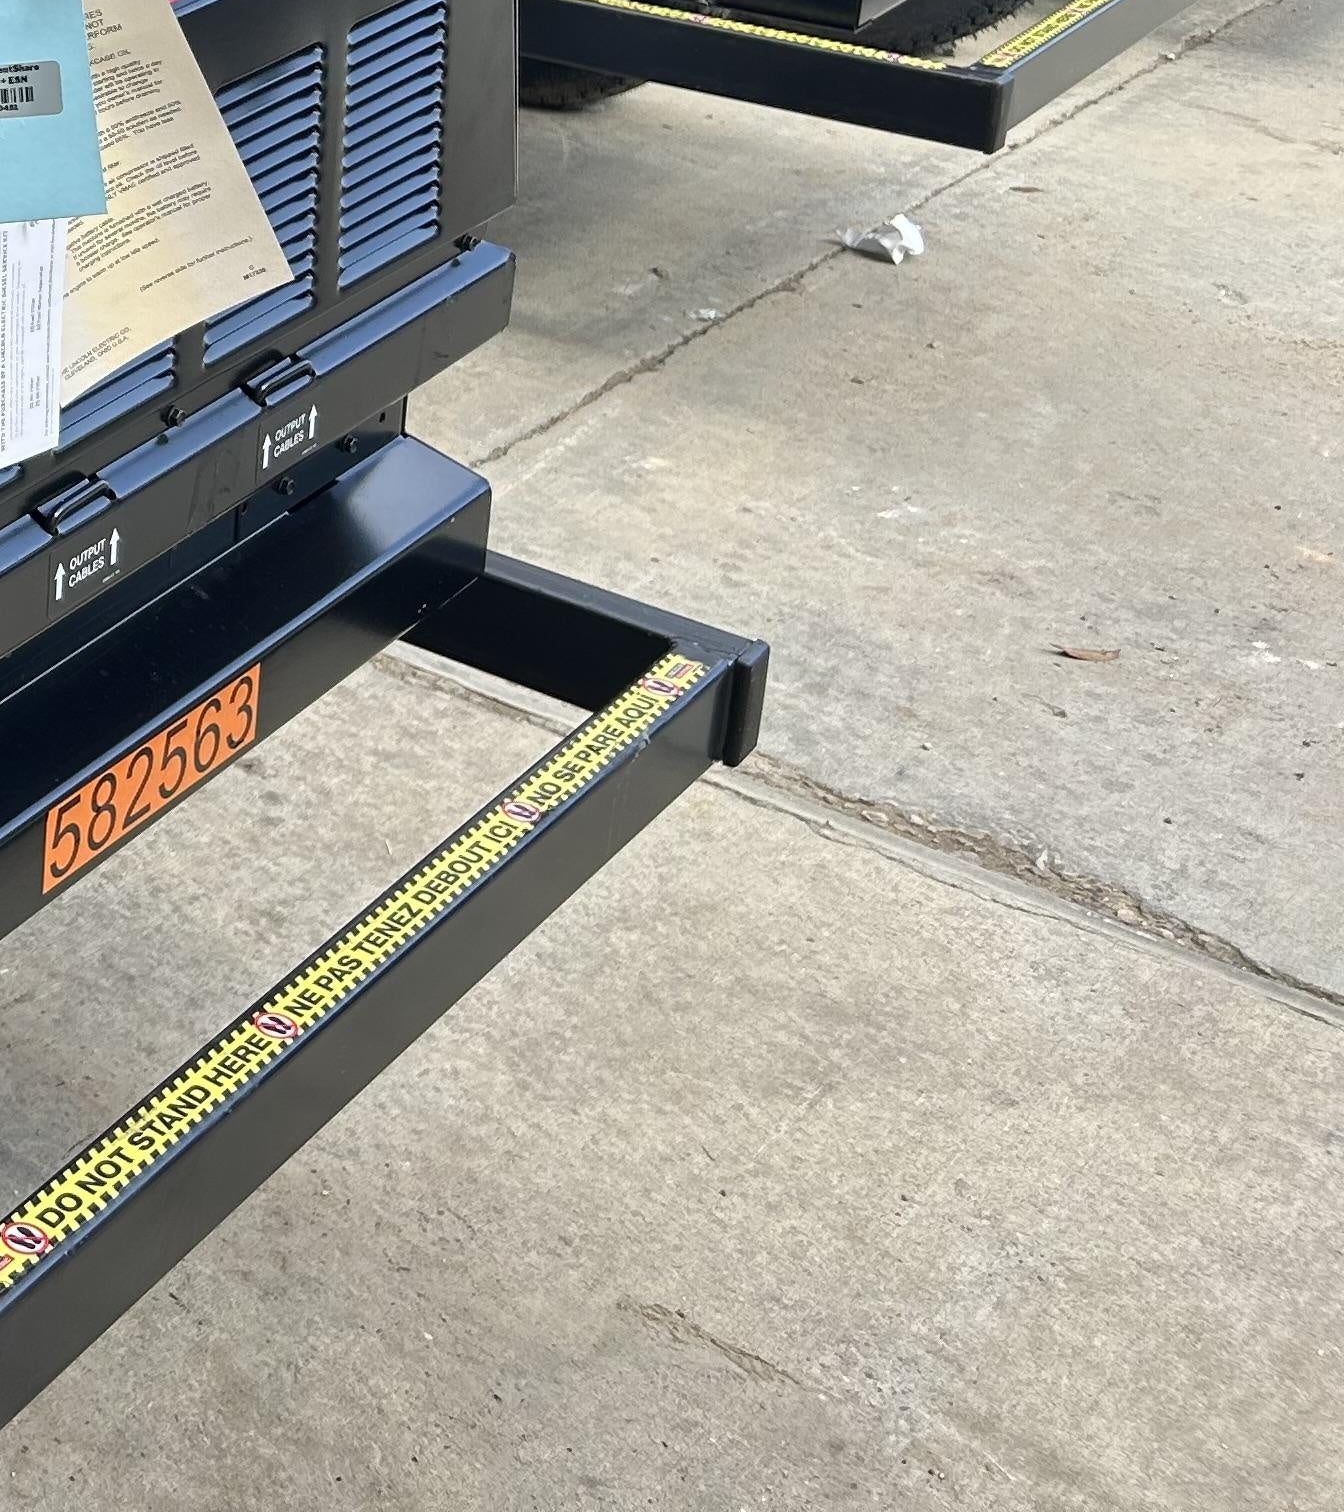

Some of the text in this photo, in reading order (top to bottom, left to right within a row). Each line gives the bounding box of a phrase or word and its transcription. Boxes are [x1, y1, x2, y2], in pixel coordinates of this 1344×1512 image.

[273, 429, 305, 459] CABLES
[274, 413, 307, 442] OUTPUT
[68, 555, 105, 588] CABLES
[69, 538, 107, 571] OUTPUT
[50, 675, 253, 878] 582563
[526, 780, 562, 807] NO
[552, 760, 585, 783] SE
[574, 724, 626, 763] PARE
[283, 820, 518, 1018] NE PAS TENEZ DEBOUT ICI
[35, 1032, 273, 1229] DO NOT STAND HERE
